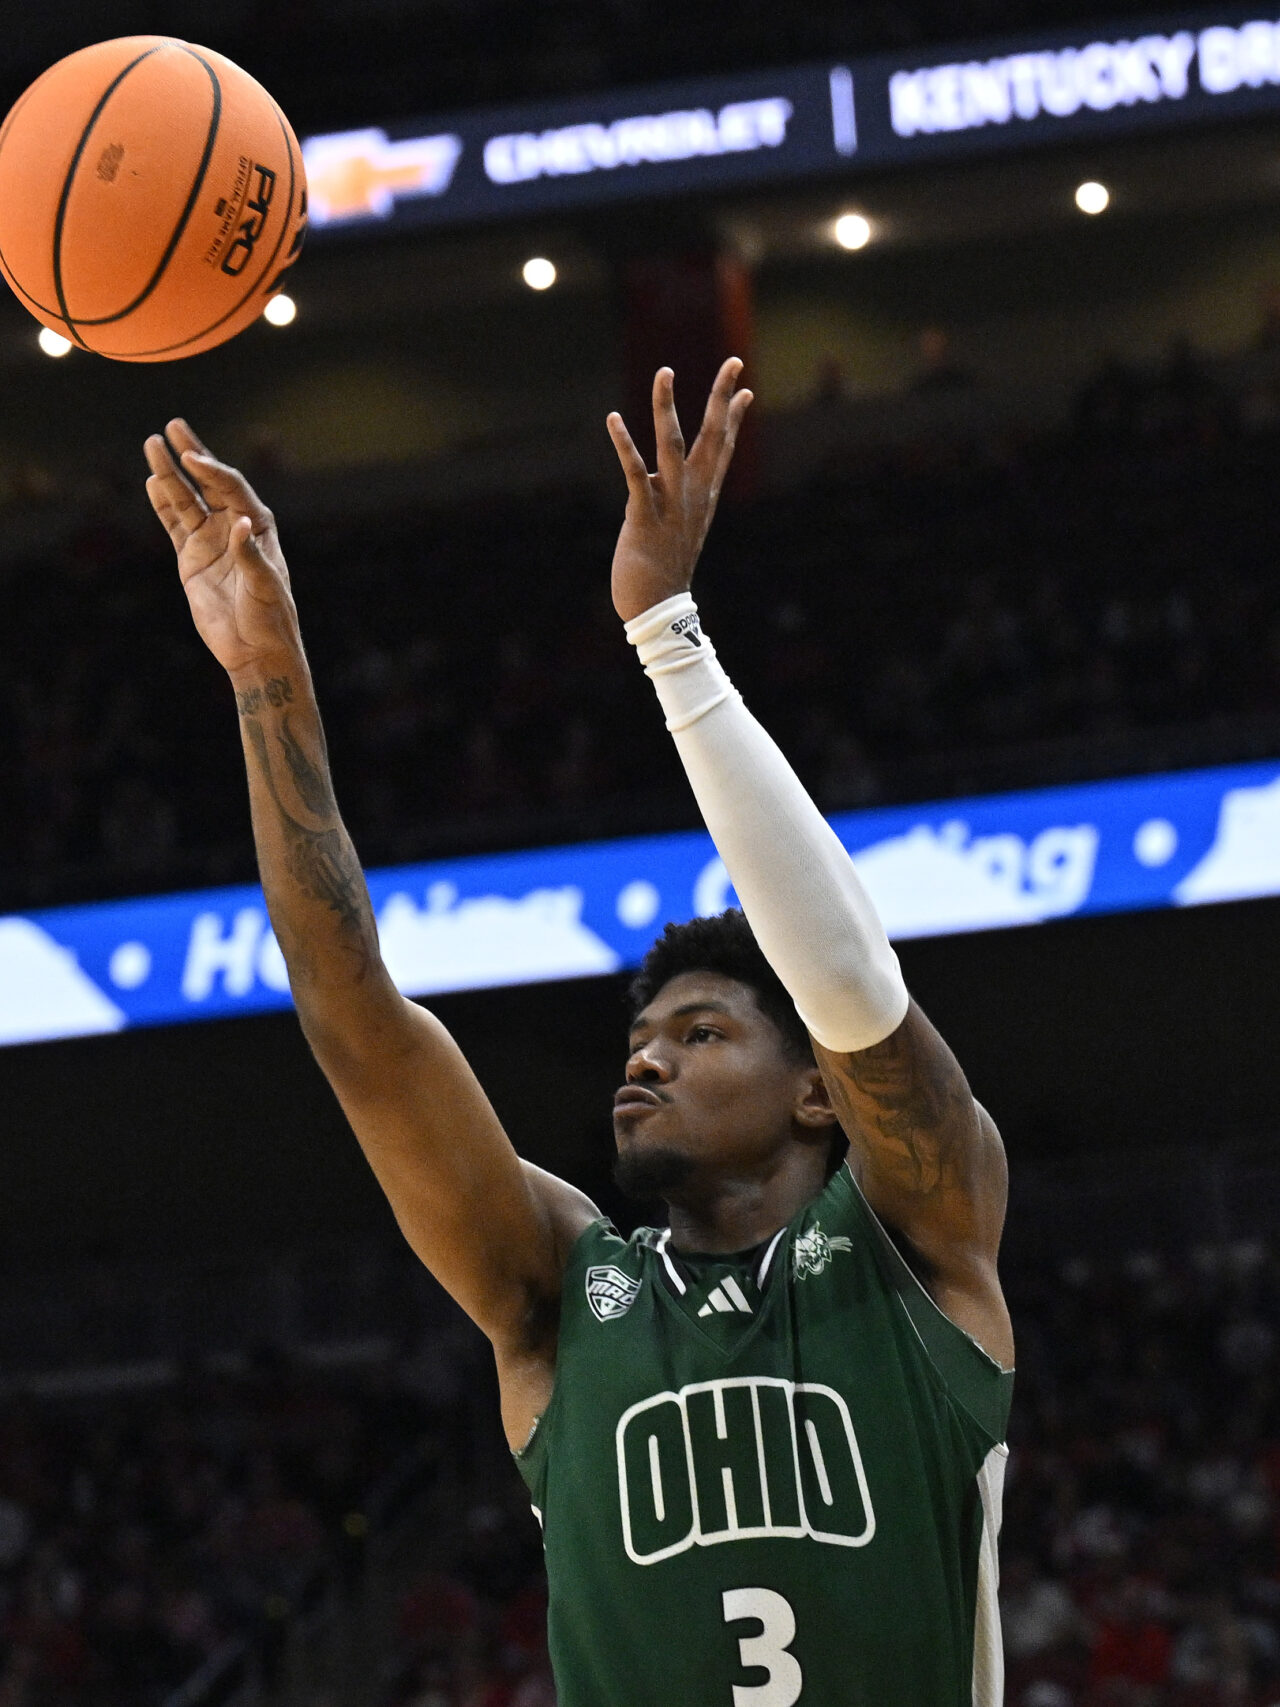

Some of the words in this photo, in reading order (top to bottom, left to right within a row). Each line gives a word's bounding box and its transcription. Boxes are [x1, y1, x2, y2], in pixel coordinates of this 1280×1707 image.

[889, 30, 1198, 138] KENTUCKY
[1197, 19, 1280, 95] DR
[483, 97, 793, 185] CHEVROLET
[221, 163, 276, 277] PRO
[588, 1281, 635, 1306] MAC
[616, 1376, 876, 1566] OHIO
[722, 1586, 803, 1707] 3
